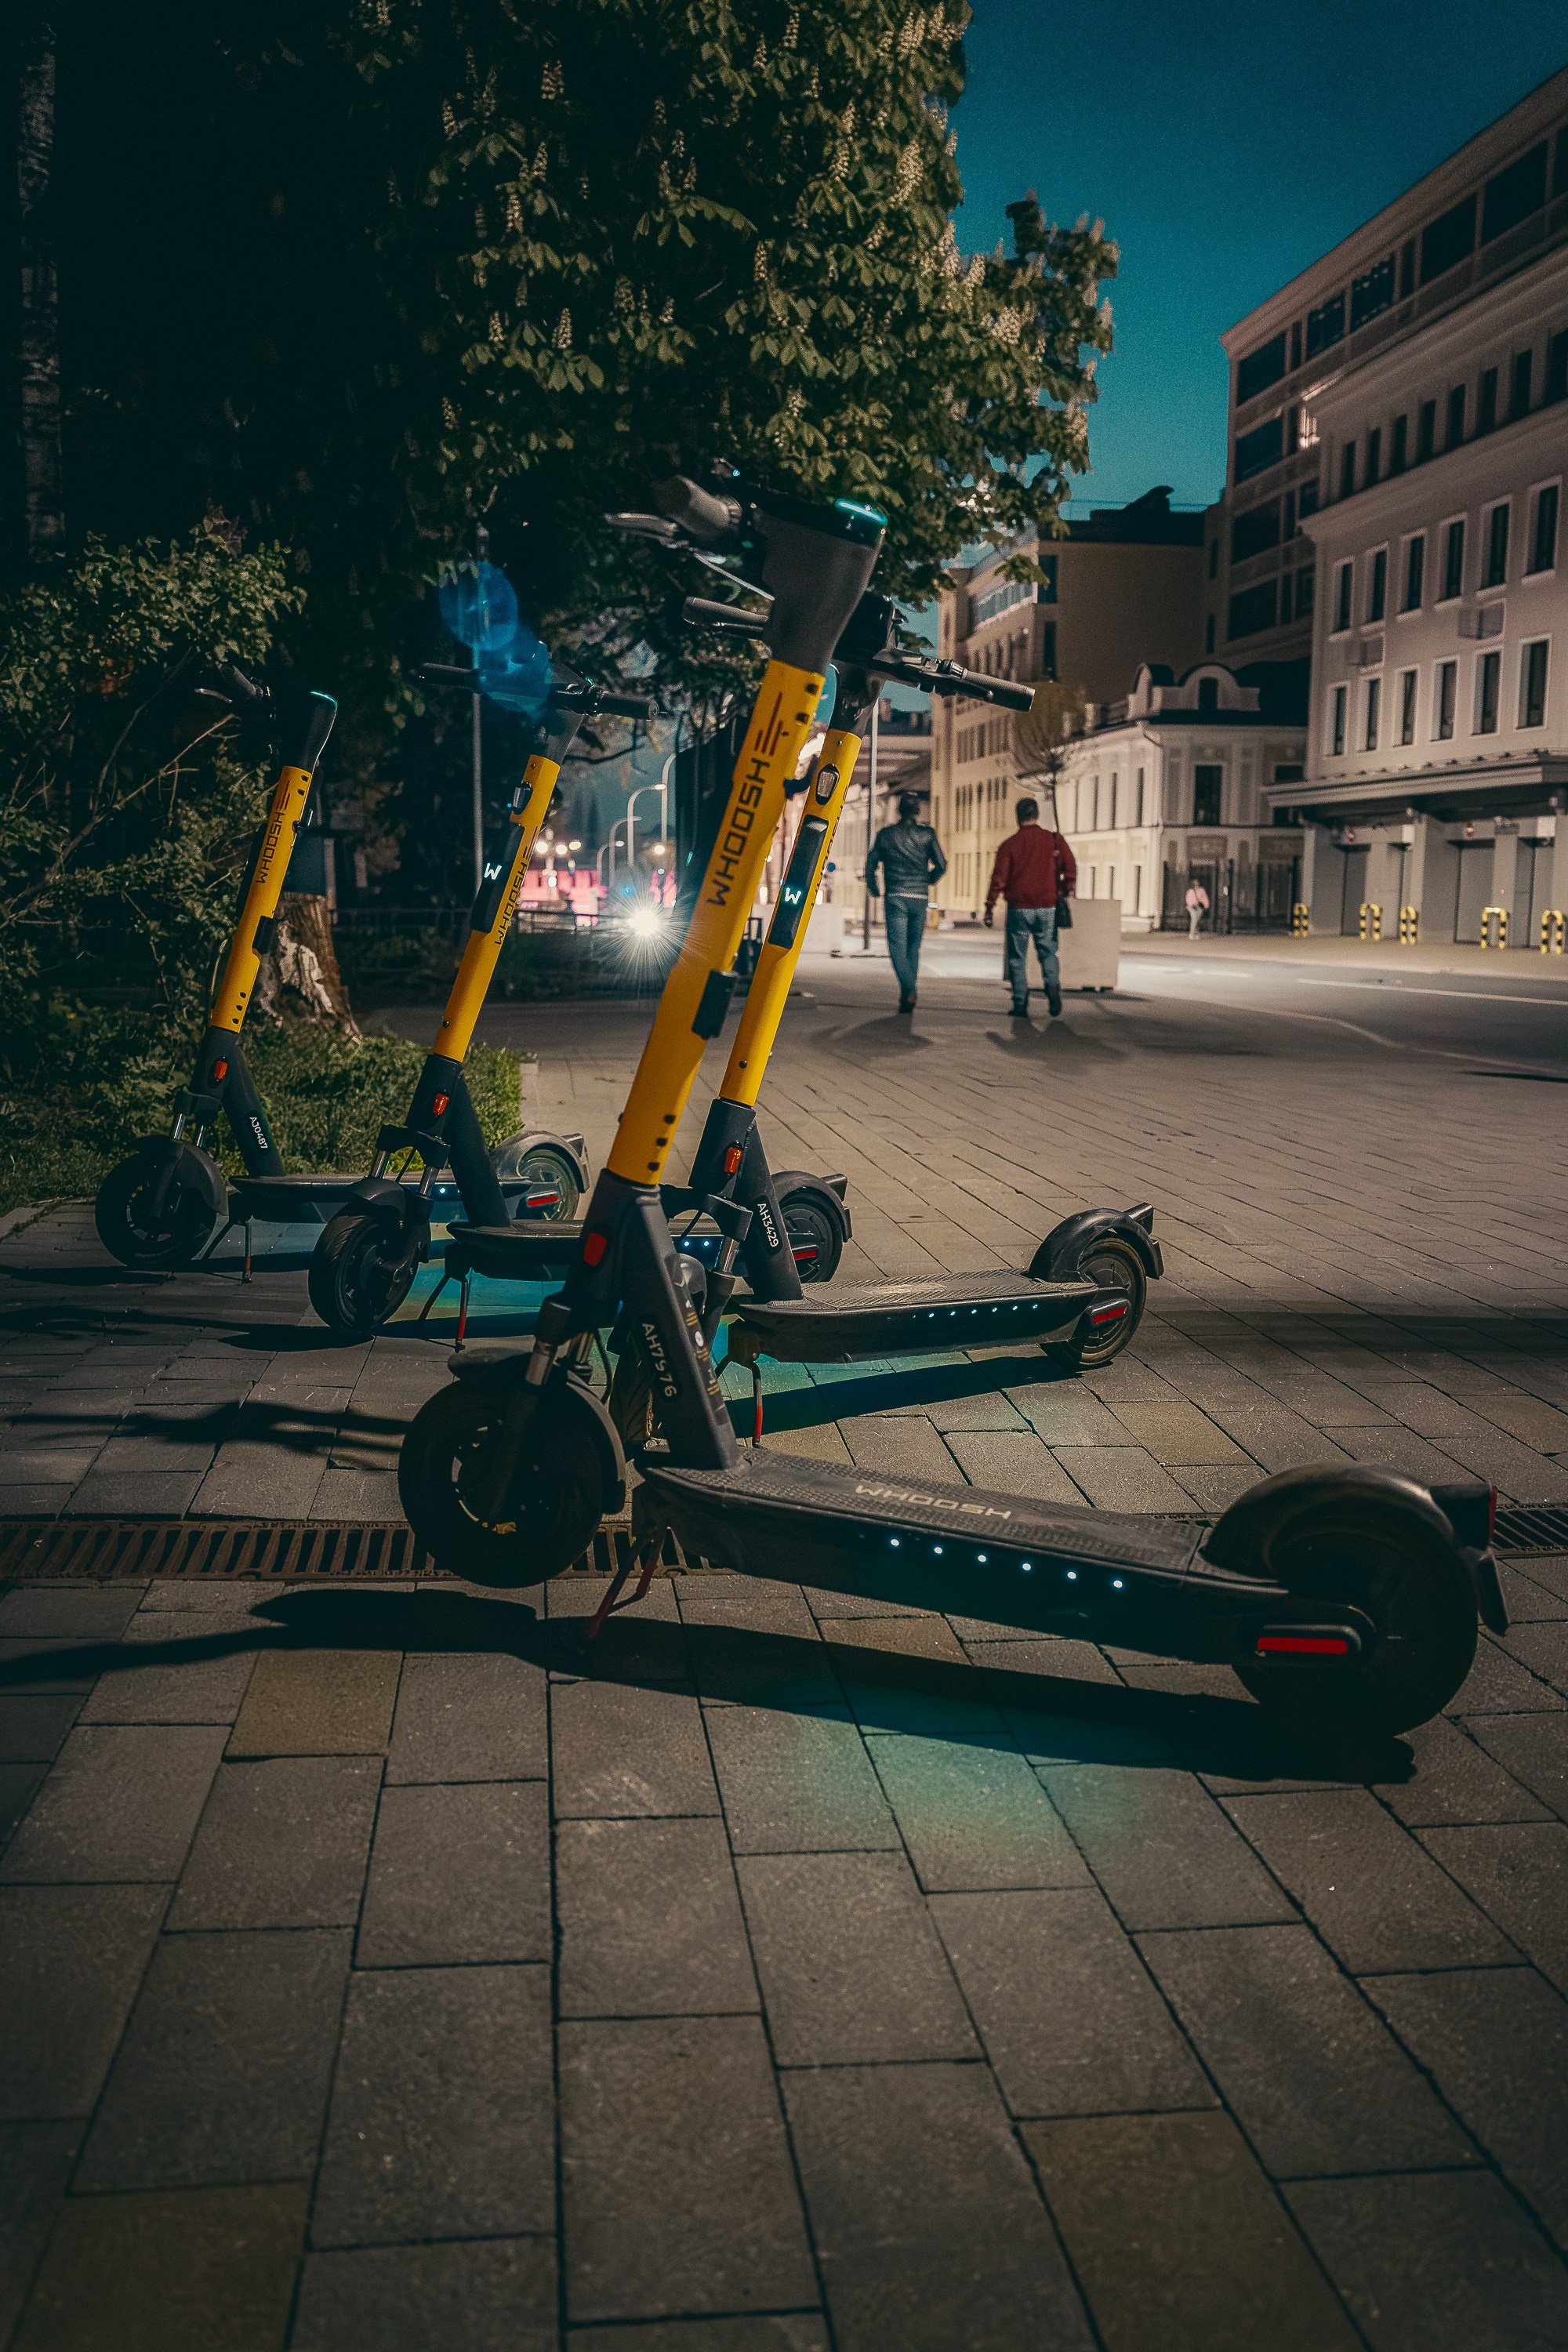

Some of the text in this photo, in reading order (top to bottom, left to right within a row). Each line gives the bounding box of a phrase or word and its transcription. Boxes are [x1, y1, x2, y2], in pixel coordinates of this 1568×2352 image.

[256, 811, 285, 884] WHOOSH
[706, 757, 771, 907] WHOOSH
[484, 862, 503, 880] W
[495, 862, 528, 946] WHOOSH
[785, 887, 801, 904] W
[249, 1116, 268, 1149] AJ0487
[757, 1203, 779, 1247] AH3429
[855, 1484, 1012, 1520] WHOOSH
